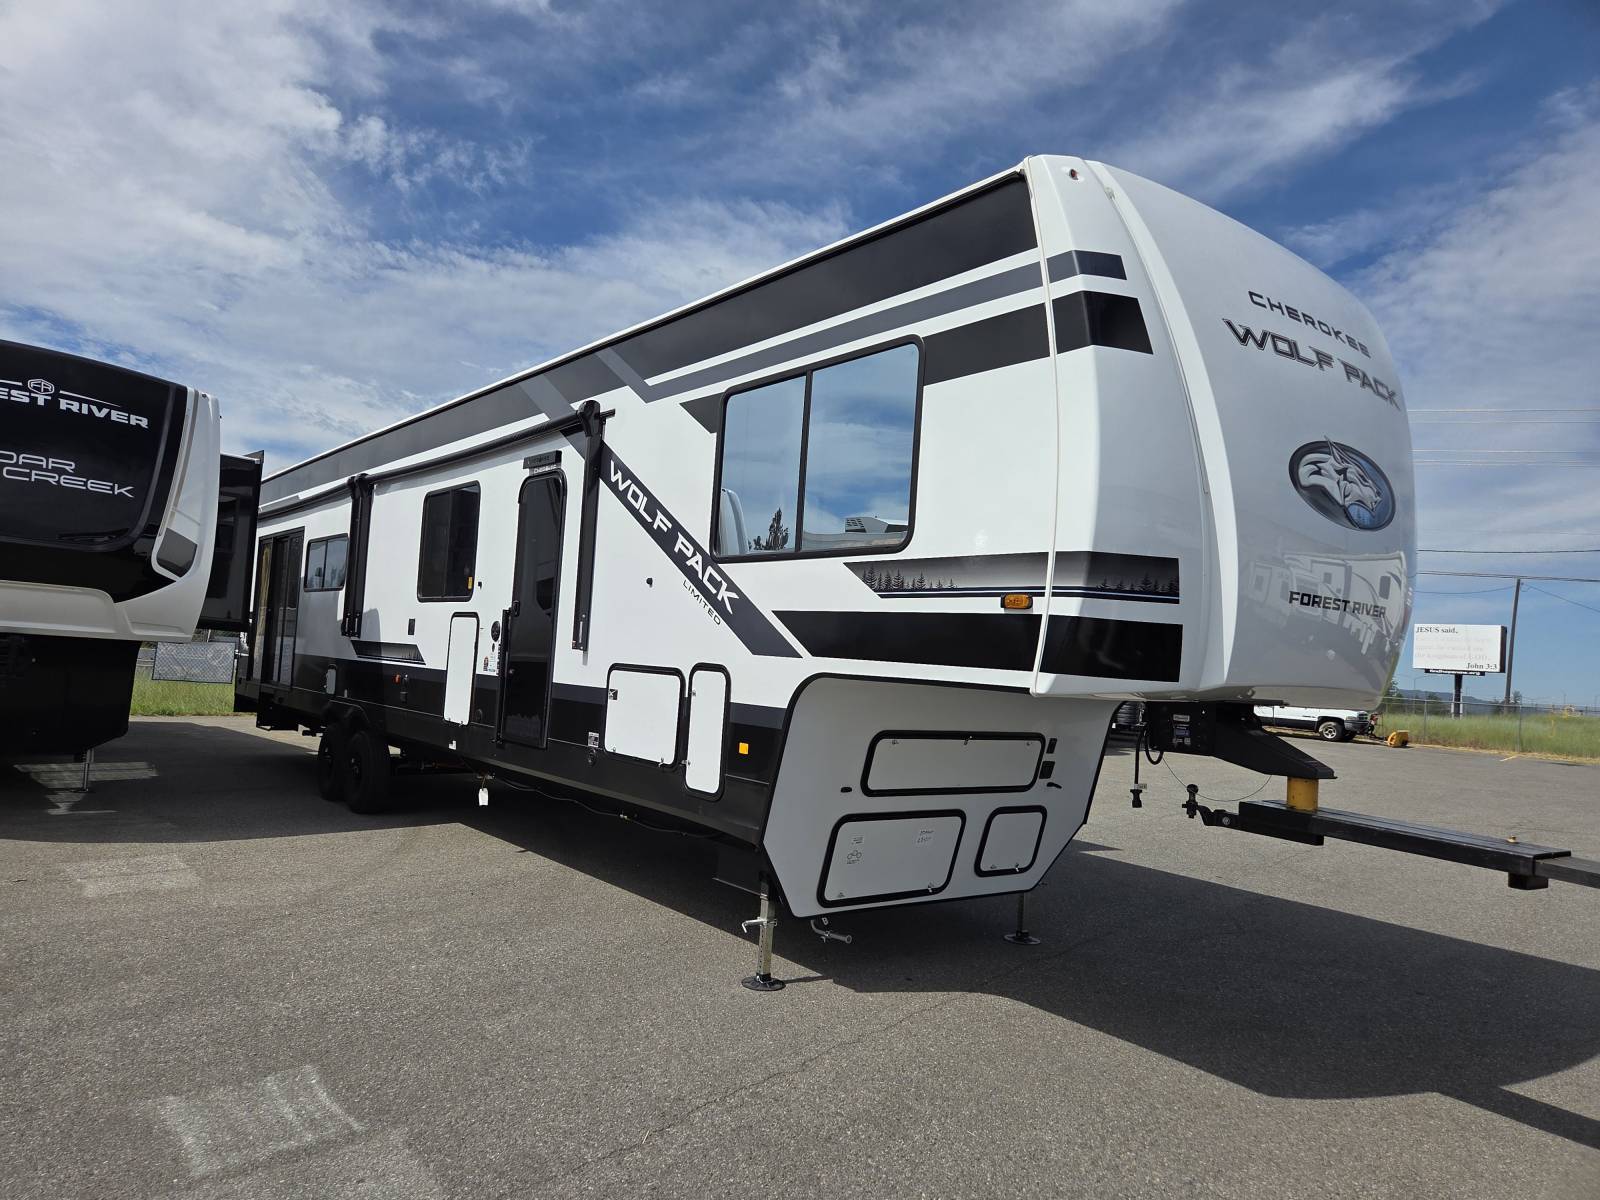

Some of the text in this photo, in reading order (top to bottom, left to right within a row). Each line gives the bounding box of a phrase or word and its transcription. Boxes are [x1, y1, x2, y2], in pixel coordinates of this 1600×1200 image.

[1248, 290, 1371, 359] CHEROKEE
[1222, 318, 1401, 411] WOLF PACK
[58, 398, 149, 428] RIVER
[3, 466, 135, 498] CREEK
[610, 459, 739, 615] WOLF PACK
[682, 579, 721, 626] LIMITED
[1288, 590, 1387, 618] FOREST RIVER
[1415, 626, 1440, 634] JESUS
